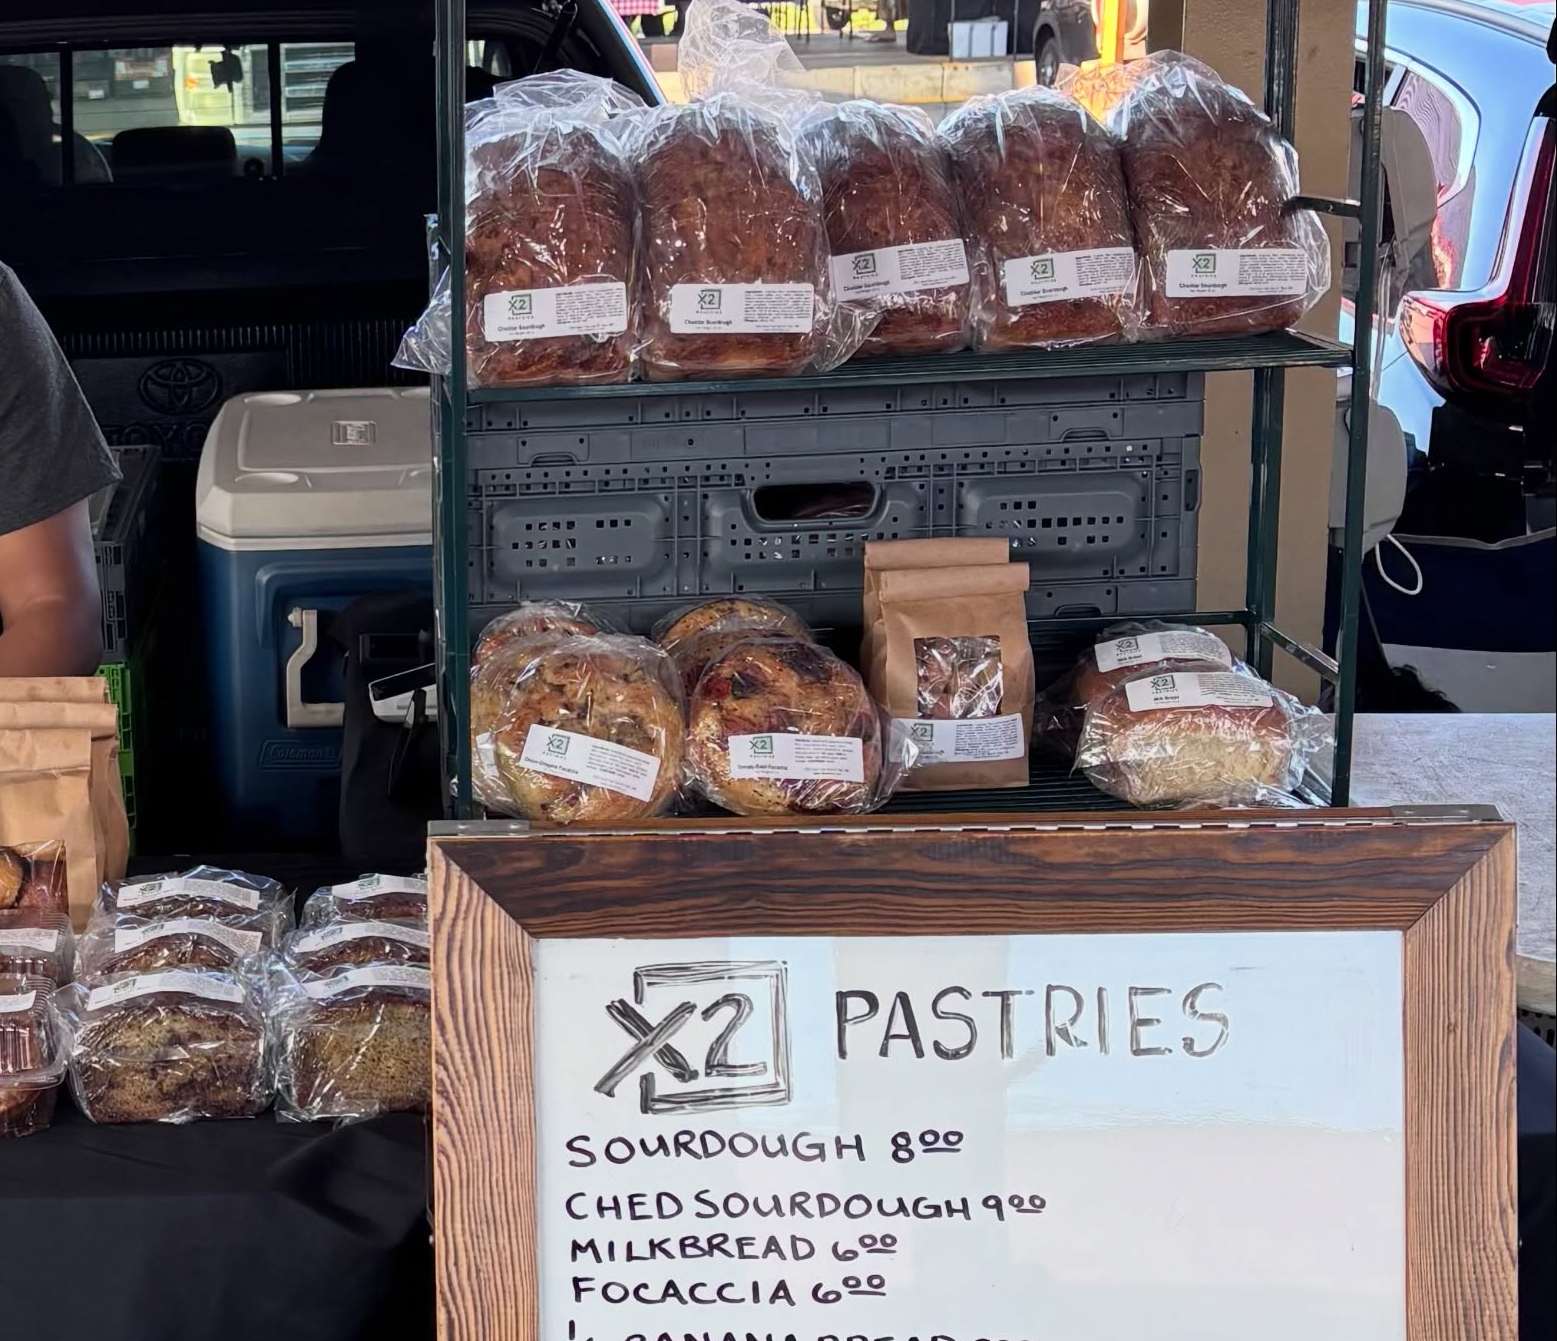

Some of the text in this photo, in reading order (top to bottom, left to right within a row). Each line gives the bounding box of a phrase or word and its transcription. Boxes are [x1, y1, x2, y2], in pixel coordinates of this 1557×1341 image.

[836, 983, 1228, 1060] PASTRIES
[566, 1130, 865, 1167] SOURDOUGH
[566, 1192, 683, 1220] CHED
[694, 1189, 971, 1220] SOURDOUGH
[572, 1276, 795, 1306] FOCACCIA
